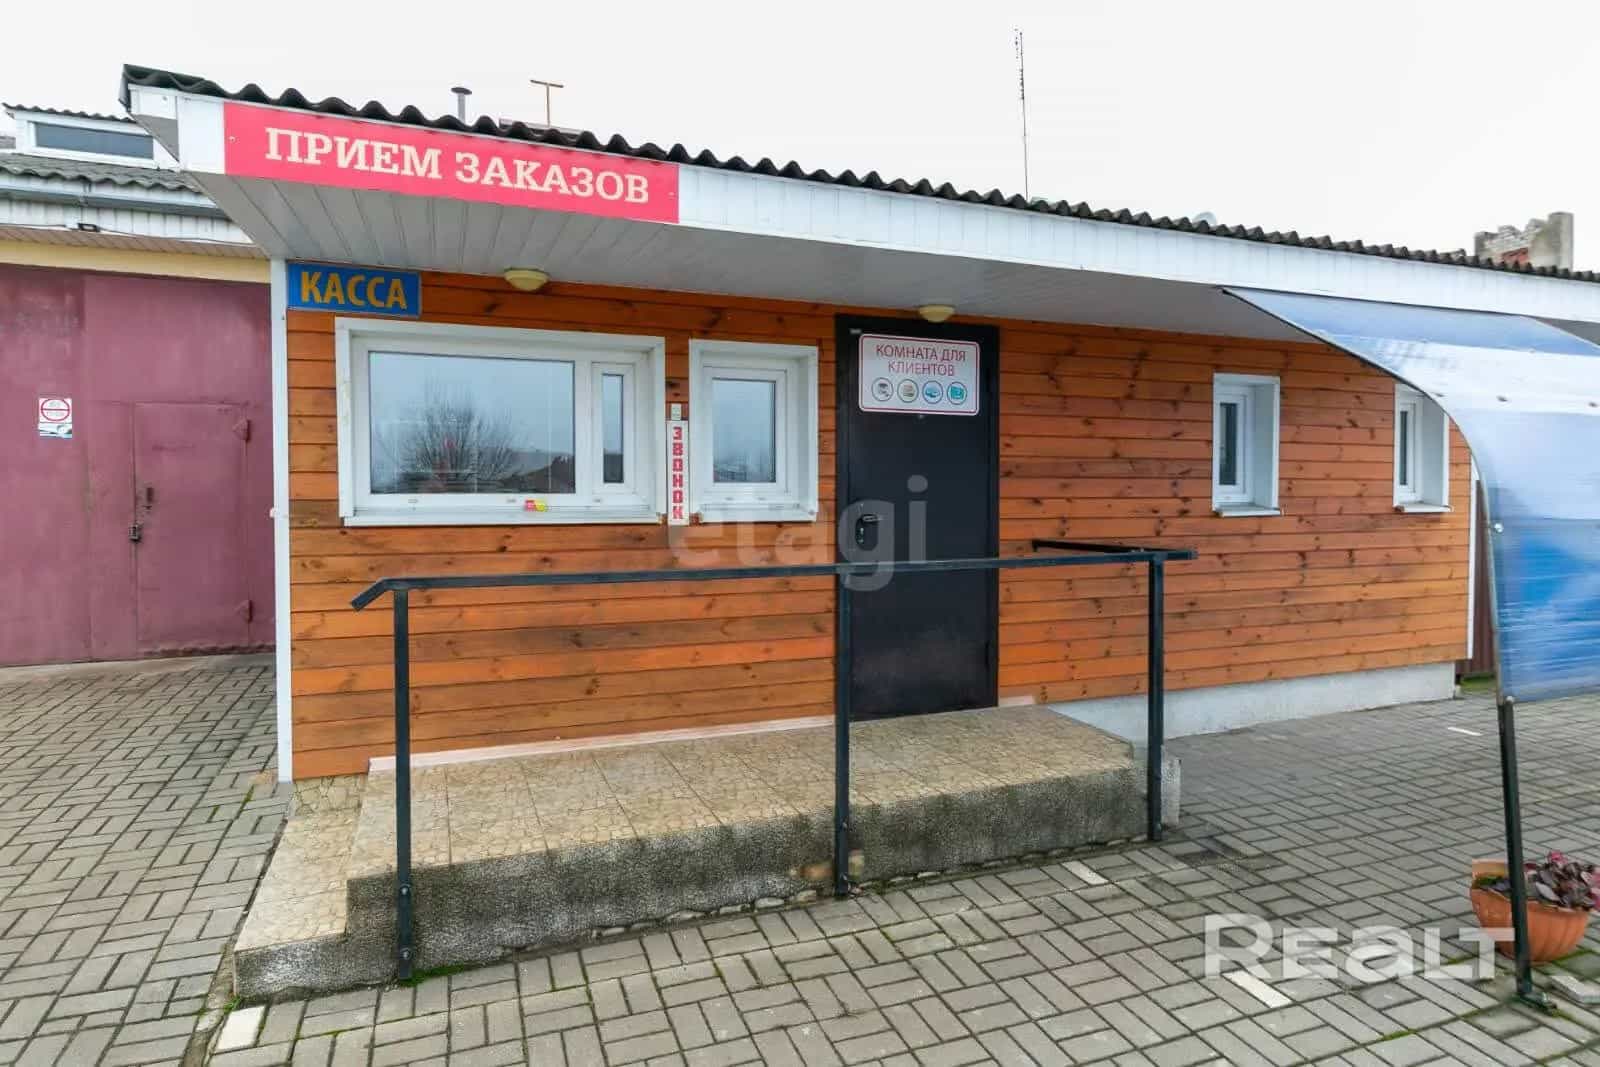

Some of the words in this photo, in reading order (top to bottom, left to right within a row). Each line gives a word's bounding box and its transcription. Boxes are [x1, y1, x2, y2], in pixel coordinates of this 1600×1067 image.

[265, 127, 442, 179] ПРИЕМ
[455, 152, 649, 204] ЗАКАЗОВ
[301, 271, 407, 310] КАССА
[876, 344, 938, 360] КОМНАТА
[940, 348, 966, 362] ДЛЯ
[888, 361, 955, 377] КЛИЕНТОВ
[672, 426, 684, 520] ЗВОНОК
